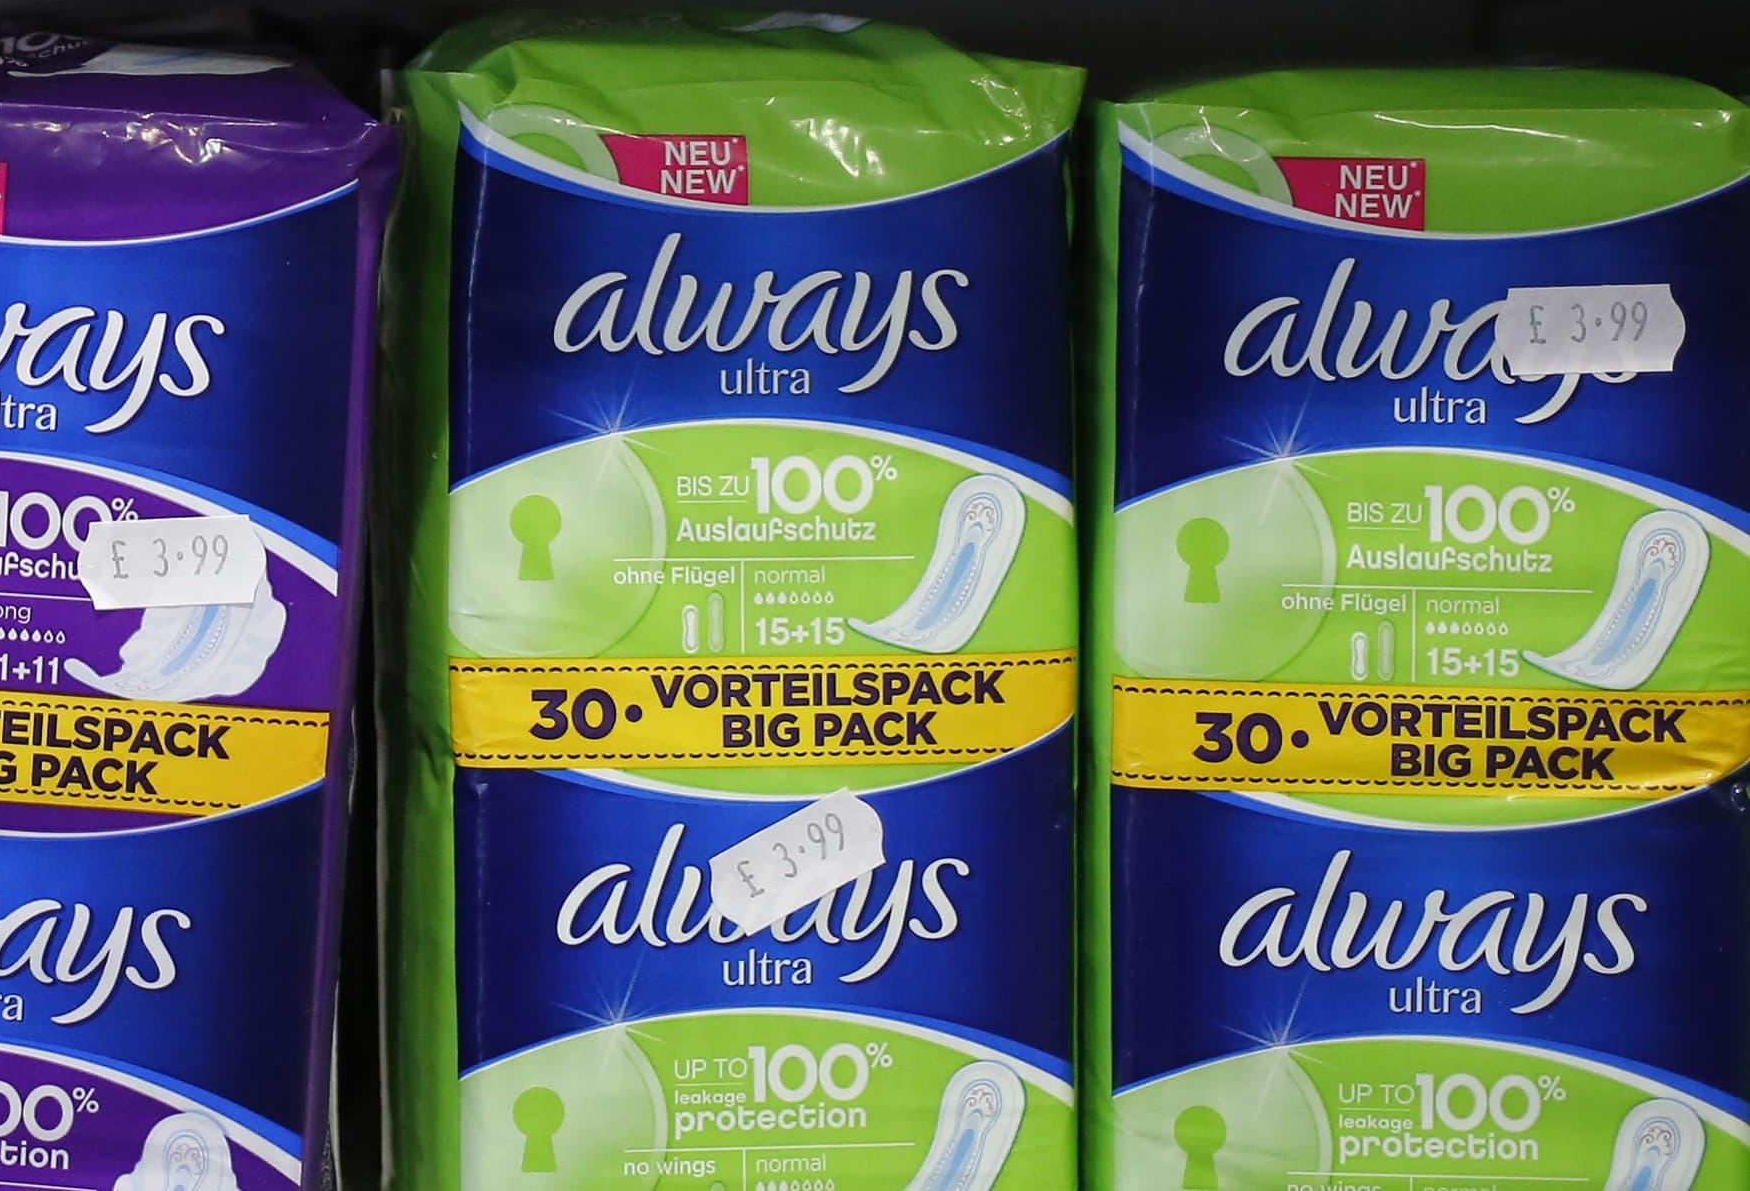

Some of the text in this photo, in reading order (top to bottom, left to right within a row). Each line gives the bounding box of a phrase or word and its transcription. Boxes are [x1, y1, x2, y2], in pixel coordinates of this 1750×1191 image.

[553, 232, 969, 394] always
[1529, 305, 1546, 344] £
[1224, 256, 1638, 425] alwa
[720, 359, 811, 396] ultra
[1392, 386, 1487, 425] ultra
[677, 455, 898, 514] BIS ZU 100%
[676, 517, 876, 543] Auslaufschutz
[1346, 484, 1576, 546] BIS ZU 100%
[111, 540, 129, 579] £
[613, 564, 735, 590] ohne Flügel
[754, 566, 826, 585] normal
[1345, 545, 1552, 574] Auslaufschutz
[1281, 592, 1407, 617] ohne Flügel
[1426, 595, 1499, 615] normal
[754, 617, 845, 646] 15+15
[1426, 647, 1520, 677] 15+15
[651, 669, 1005, 709] VORTEILSPACK
[722, 711, 937, 748] BIG PACK
[1318, 700, 1686, 744] VORTEILSPACK
[30, 755, 160, 795] PACK
[1390, 744, 1614, 781] BIG PACK
[736, 860, 765, 899] £
[1219, 849, 1648, 1015] always
[722, 948, 813, 986] ultra
[1389, 977, 1482, 1015] ultra
[673, 1042, 893, 1102] UP TO 100%
[674, 1088, 747, 1108] leakage
[1338, 1073, 1566, 1133] UP TO 100%
[674, 1103, 867, 1140] protection
[1338, 1113, 1413, 1134] leakage
[624, 1157, 716, 1177] no wings
[756, 1153, 826, 1173] normal
[1338, 1132, 1538, 1165] protection
